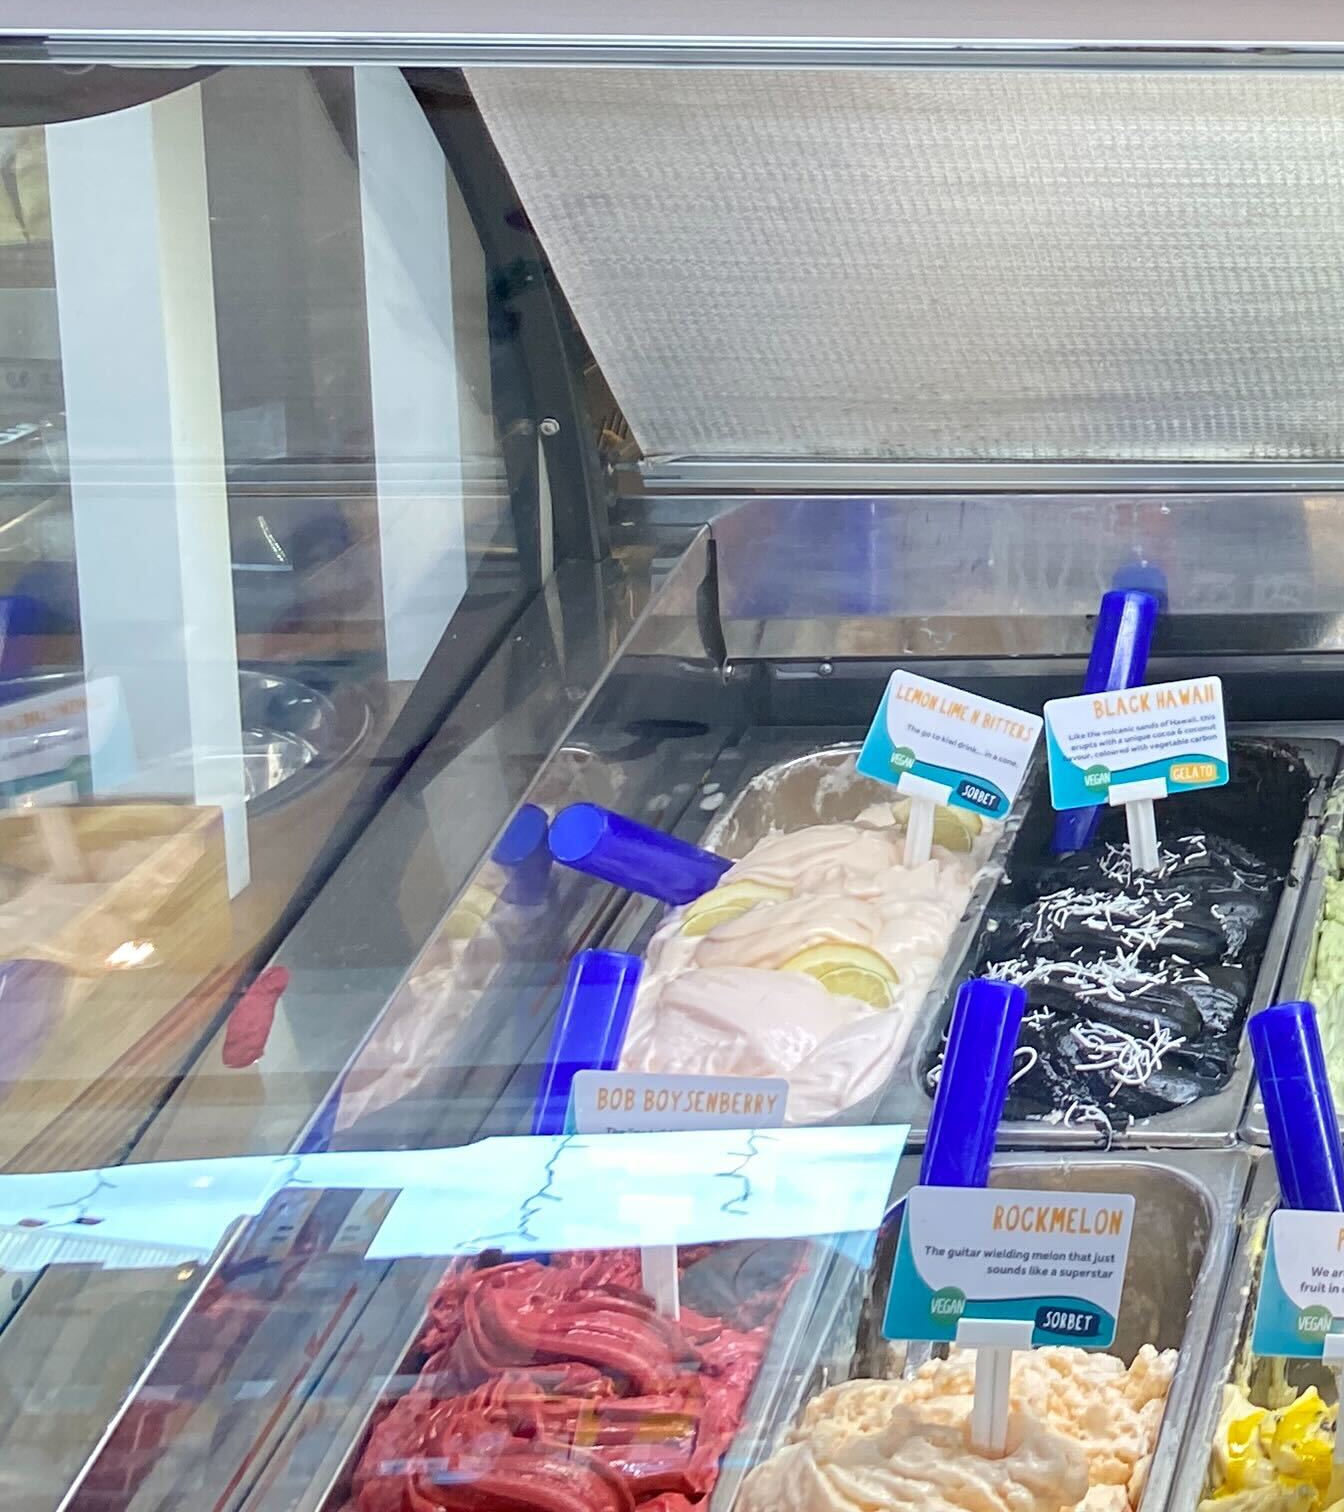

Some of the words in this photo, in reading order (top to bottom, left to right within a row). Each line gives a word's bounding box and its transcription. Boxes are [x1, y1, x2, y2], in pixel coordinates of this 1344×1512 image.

[895, 683, 937, 710] LEMON
[939, 698, 969, 721] LIME
[1093, 695, 1150, 720] BLACK
[1156, 684, 1215, 709] HAWAII
[1084, 771, 1111, 787] VEGAN
[1172, 764, 1213, 781] GELATO
[961, 784, 997, 806] SORBET
[597, 1087, 636, 1112] BOB
[643, 1088, 779, 1115] BOYSENBERRY
[992, 1204, 1123, 1235] ROCKMELON
[947, 1246, 981, 1259] guitar
[983, 1248, 1030, 1262] wielding
[1031, 1250, 1066, 1262] melon
[1068, 1251, 1091, 1263] that
[1092, 1252, 1116, 1264] just
[987, 1265, 1027, 1276] sounds
[1028, 1265, 1048, 1276] like
[1059, 1267, 1114, 1280] superstar
[930, 1298, 965, 1315] VEGAN
[1042, 1311, 1094, 1332] SORBET
